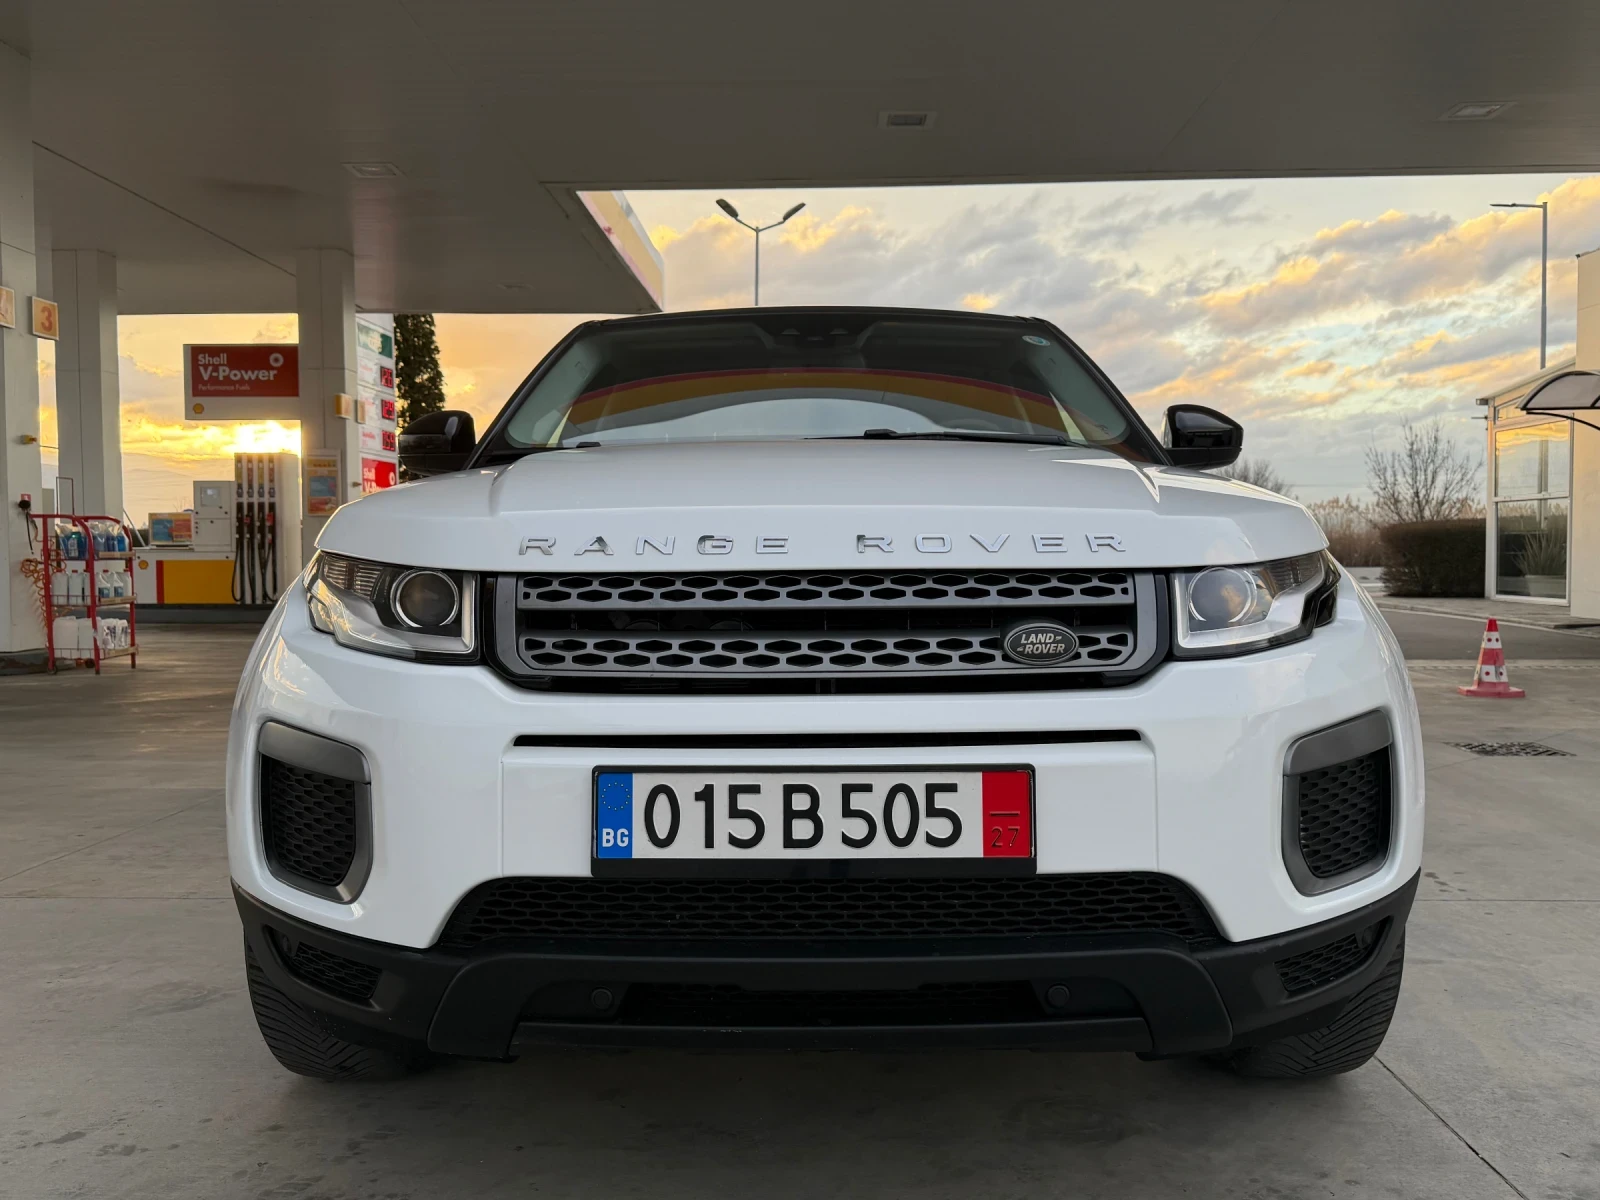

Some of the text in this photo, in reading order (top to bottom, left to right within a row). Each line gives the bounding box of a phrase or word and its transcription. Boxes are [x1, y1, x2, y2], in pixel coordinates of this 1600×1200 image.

[41, 306, 53, 332] 3
[198, 353, 227, 364] Shell
[199, 366, 277, 380] V-Power
[519, 533, 1126, 556] RANGE ROVER
[1020, 633, 1054, 643] LAND
[1024, 643, 1065, 654] ROVER
[602, 828, 629, 847] BG
[991, 826, 1020, 847] 27
